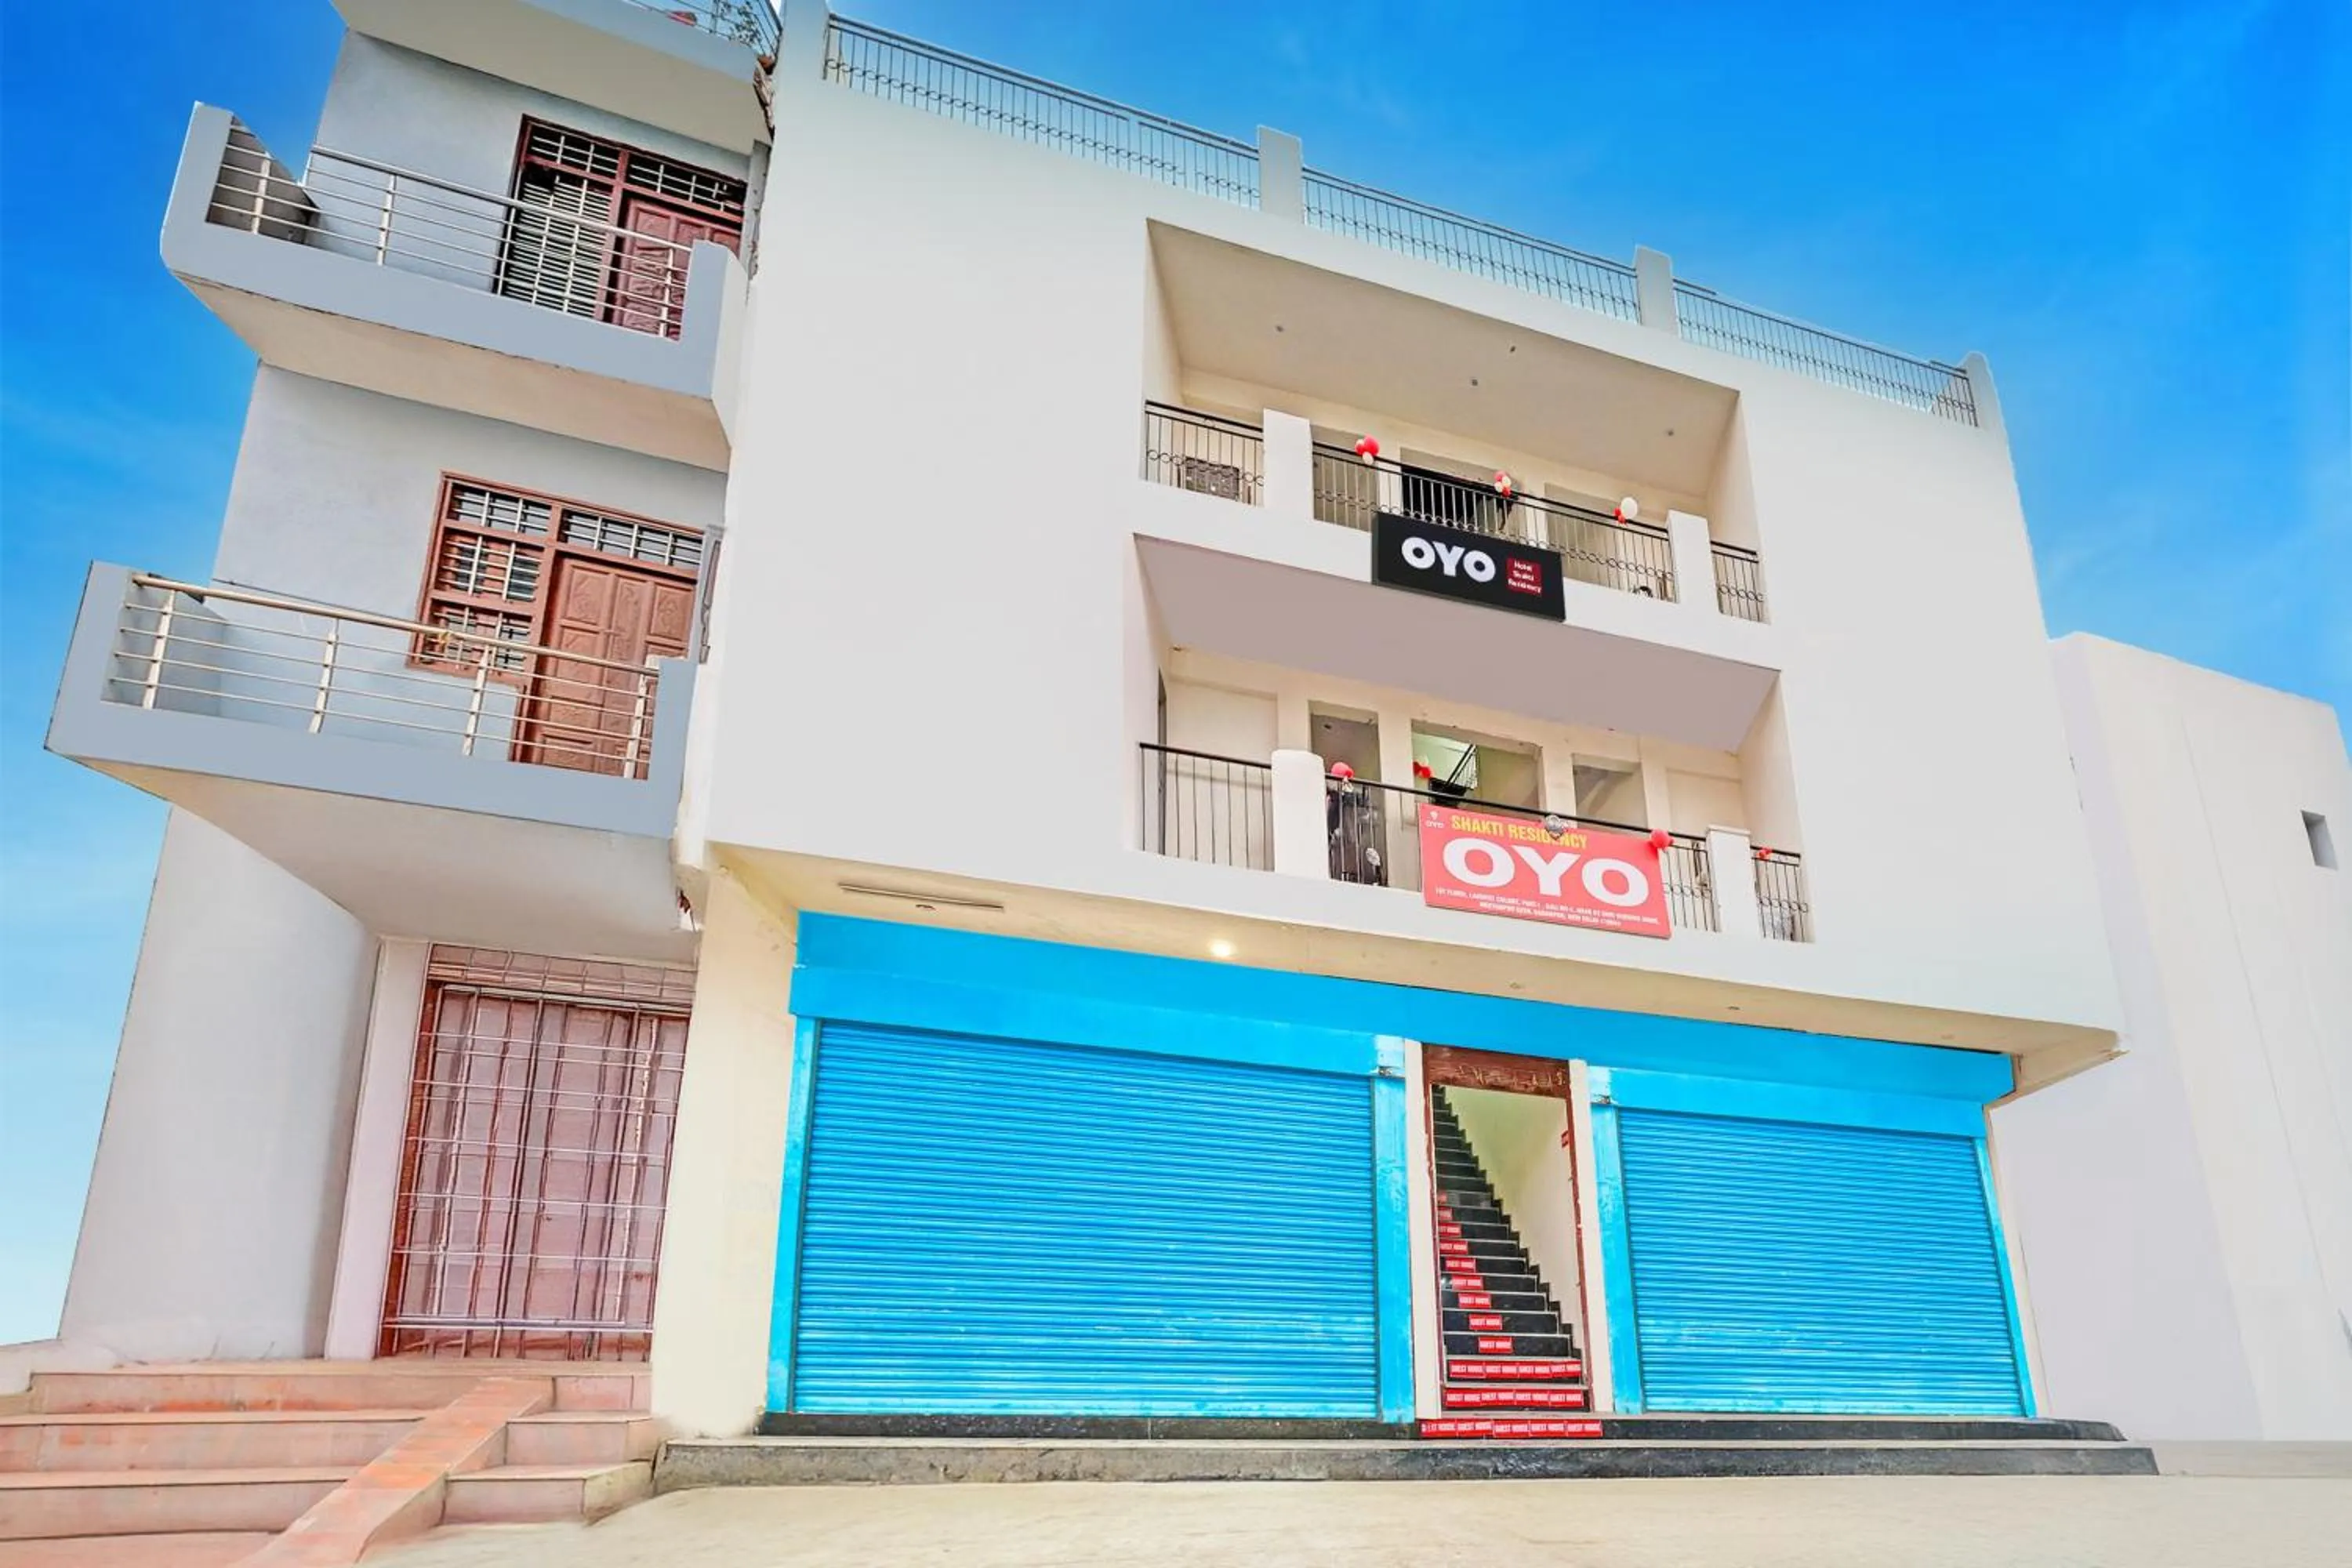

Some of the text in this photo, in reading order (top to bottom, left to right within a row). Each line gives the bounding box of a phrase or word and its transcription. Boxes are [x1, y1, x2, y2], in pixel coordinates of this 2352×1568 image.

[1401, 537, 1496, 583] OYO
[1451, 815, 1588, 849] SHAKTI RESIDNCY
[1443, 837, 1650, 907] OYO
